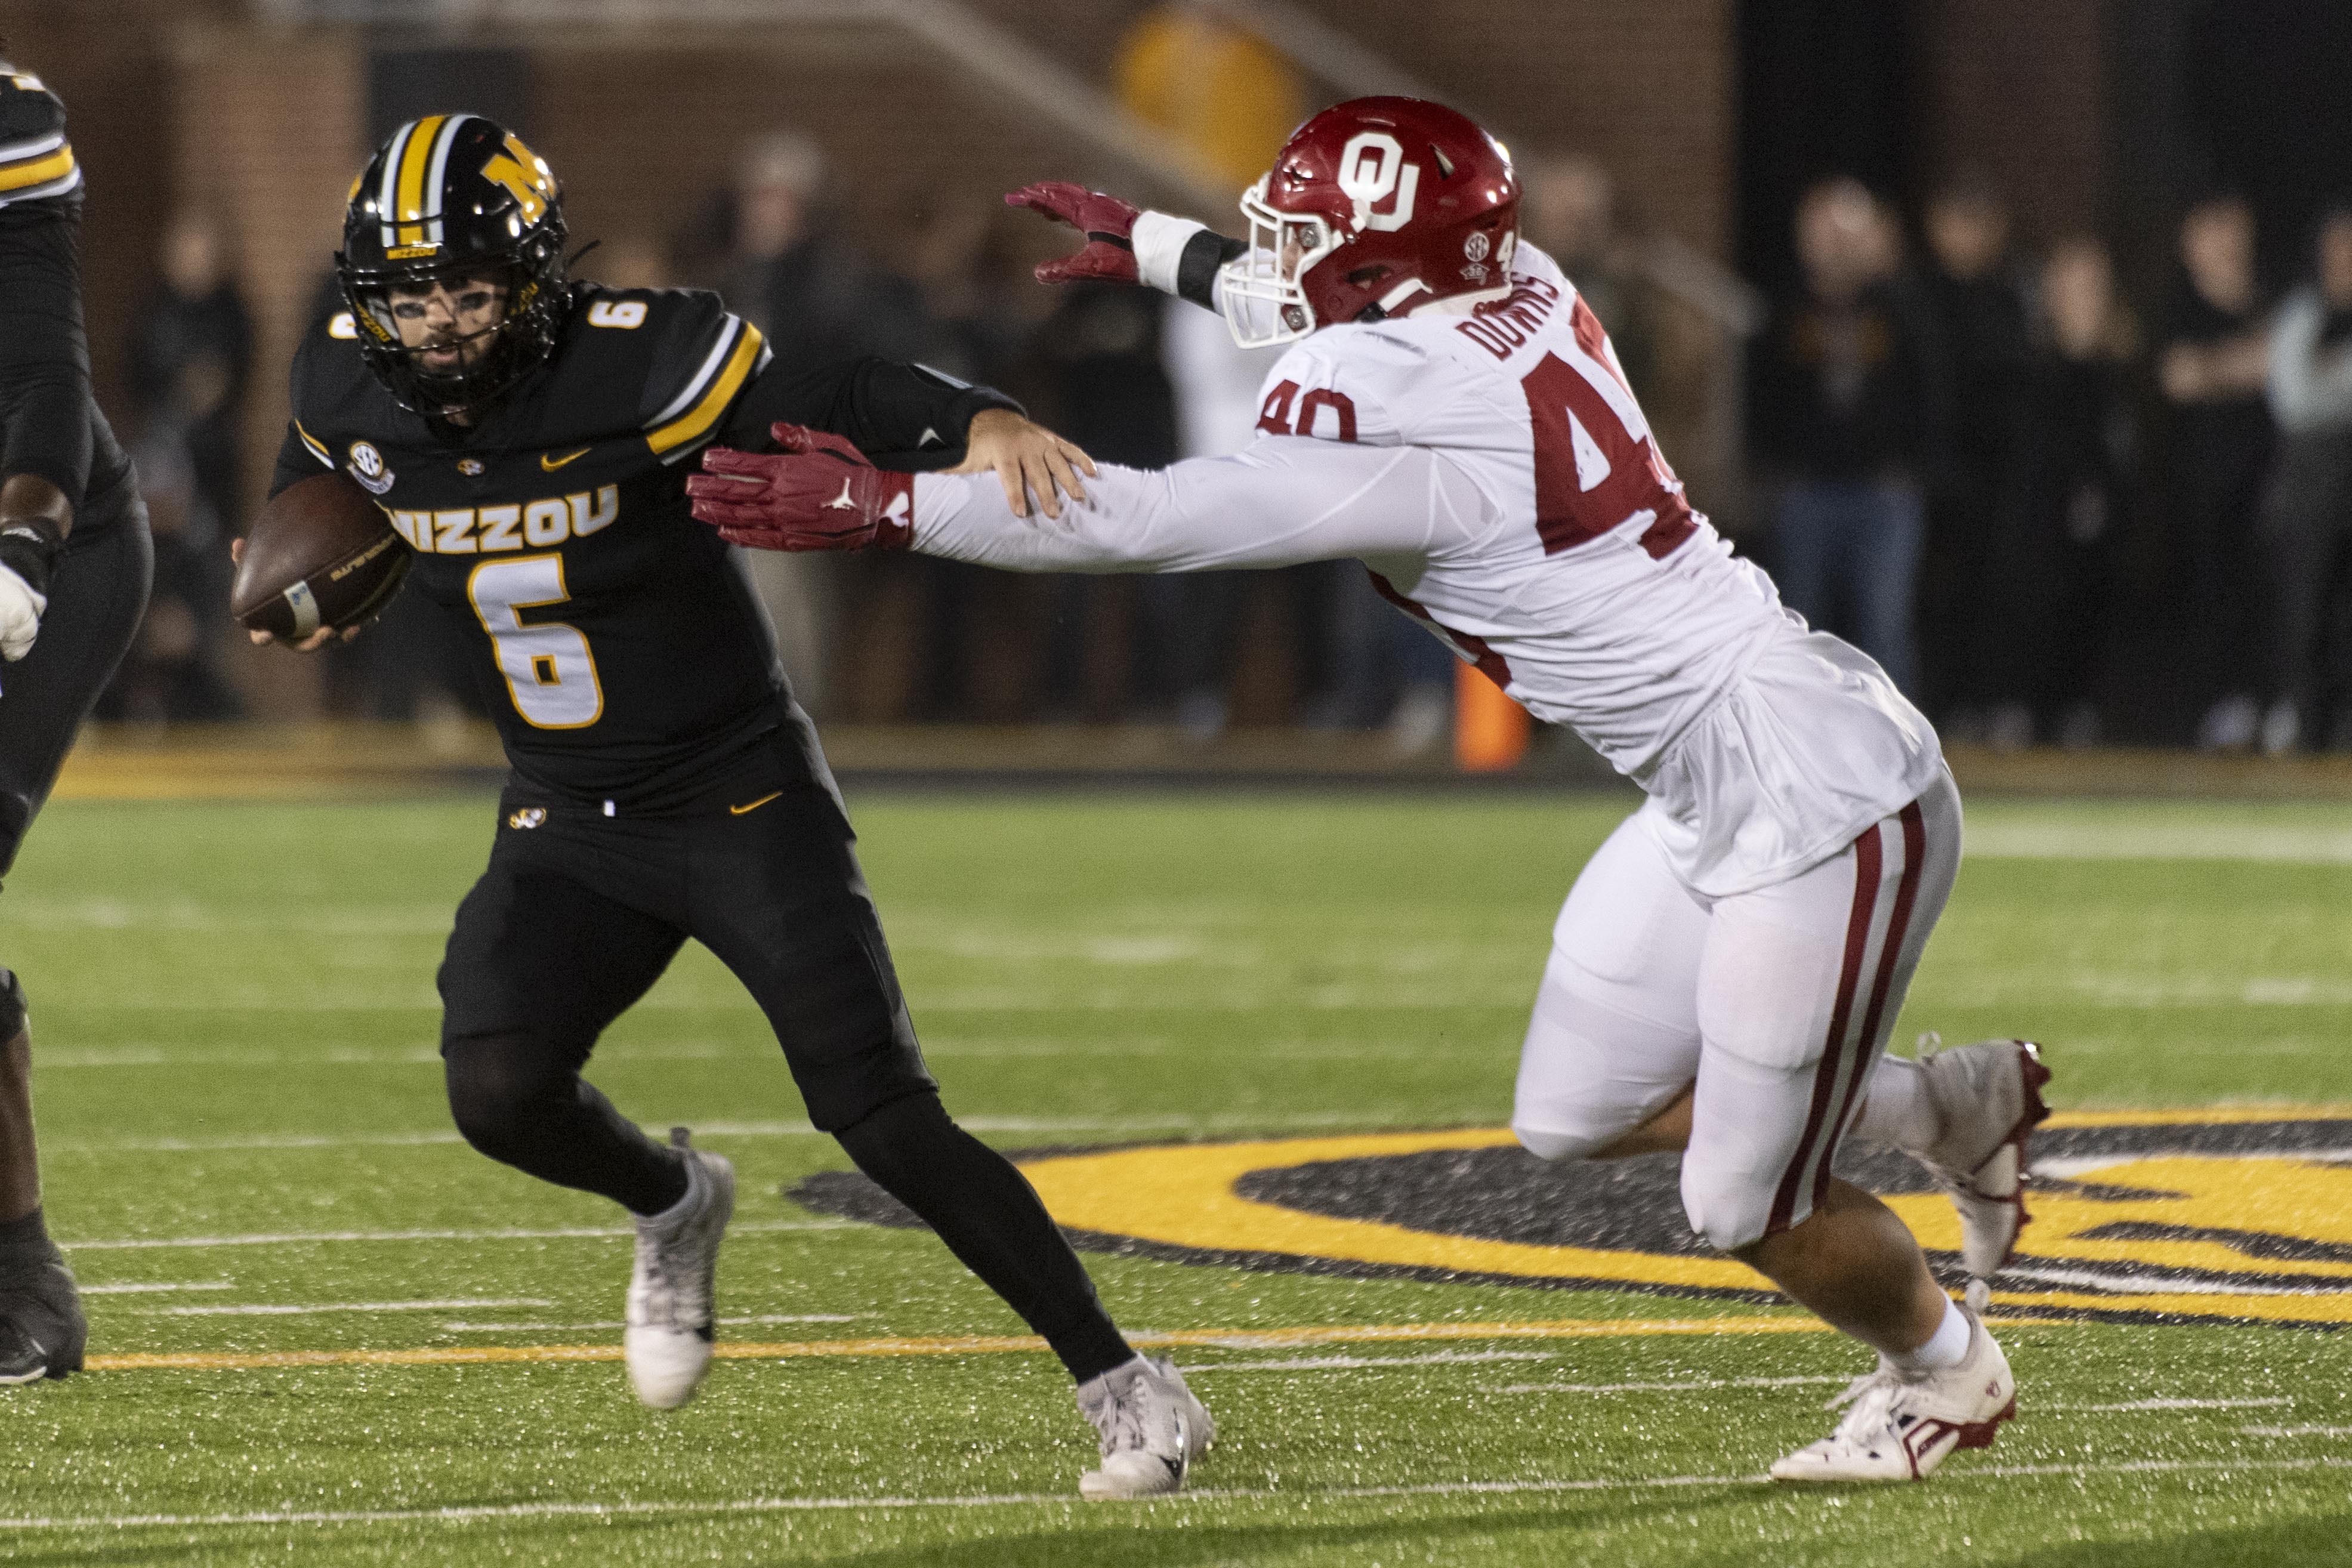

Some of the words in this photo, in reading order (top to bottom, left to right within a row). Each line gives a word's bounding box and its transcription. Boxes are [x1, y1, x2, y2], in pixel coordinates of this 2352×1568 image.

[480, 132, 557, 229] M
[1338, 132, 1420, 233] OU
[587, 300, 649, 330] 6
[1255, 379, 1358, 443] 40
[466, 551, 604, 730] 6
